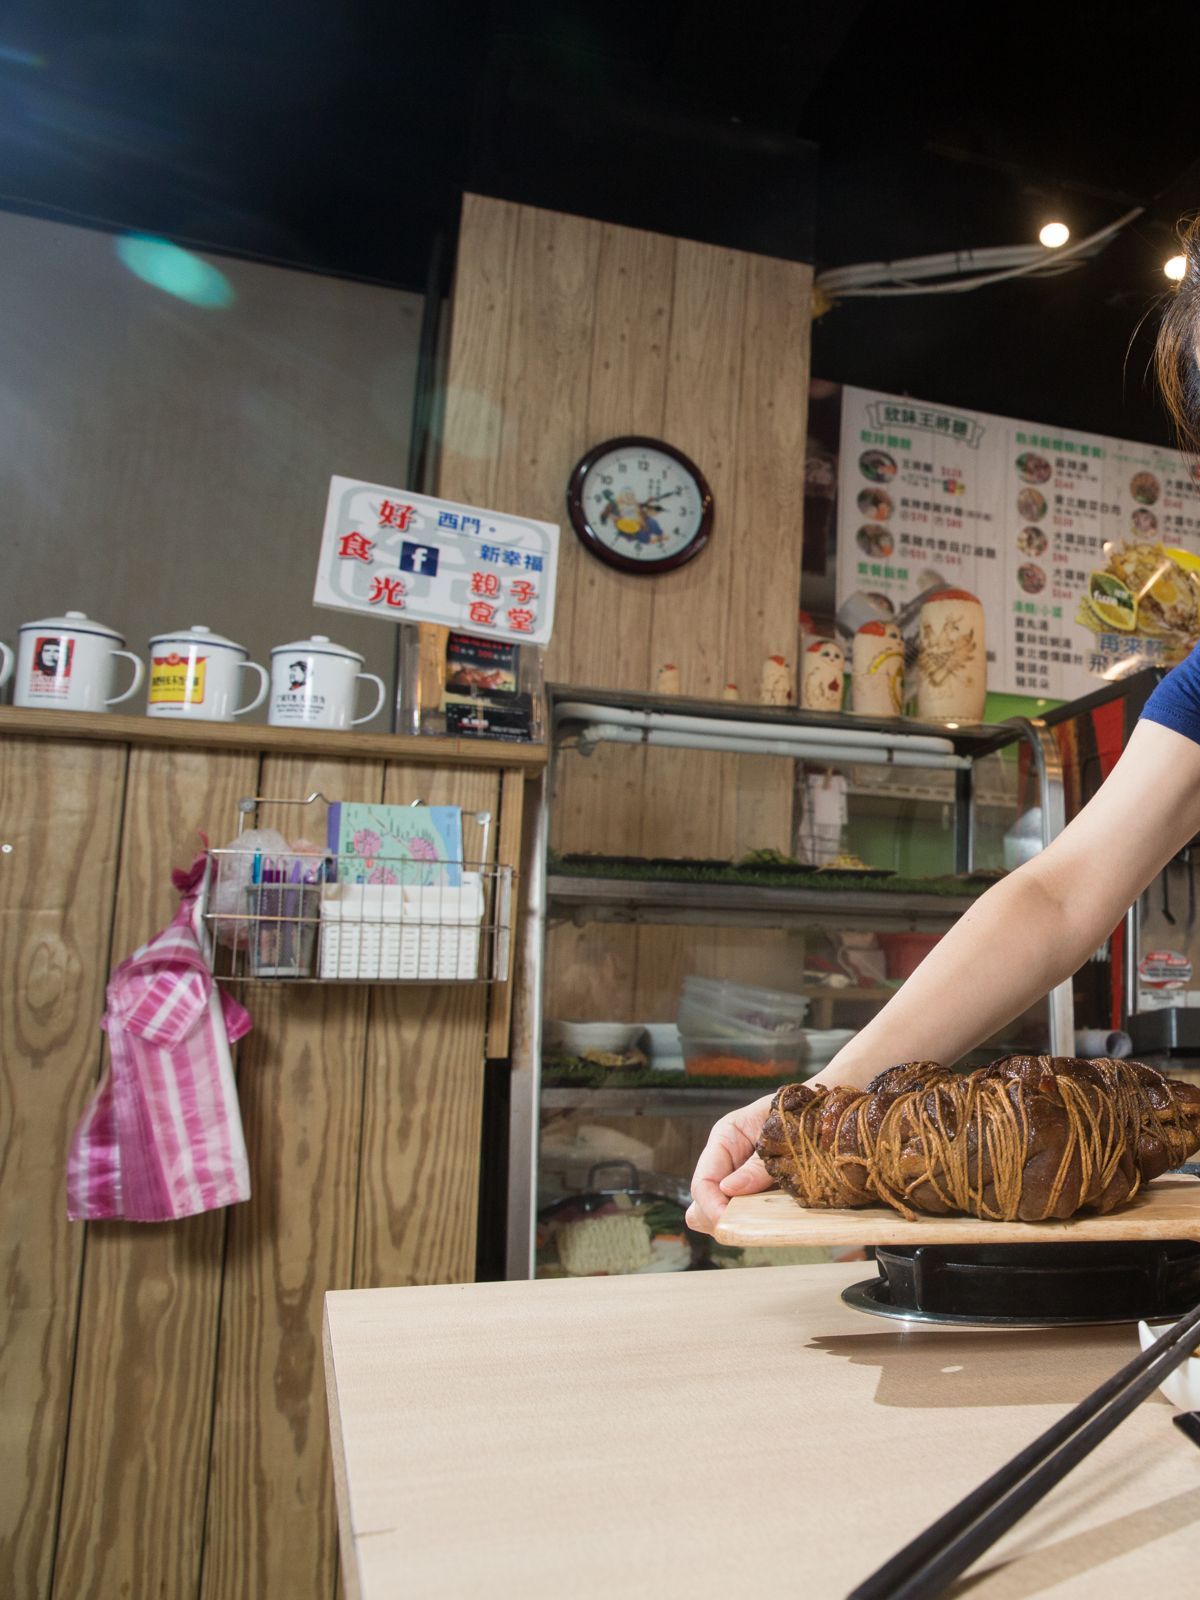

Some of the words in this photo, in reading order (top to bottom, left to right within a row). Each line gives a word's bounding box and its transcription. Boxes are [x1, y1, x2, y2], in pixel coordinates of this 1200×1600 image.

[638, 460, 649, 471] 12
[480, 543, 544, 573] 新幸福
[470, 571, 537, 604] 親子
[469, 600, 535, 633] 食堂
